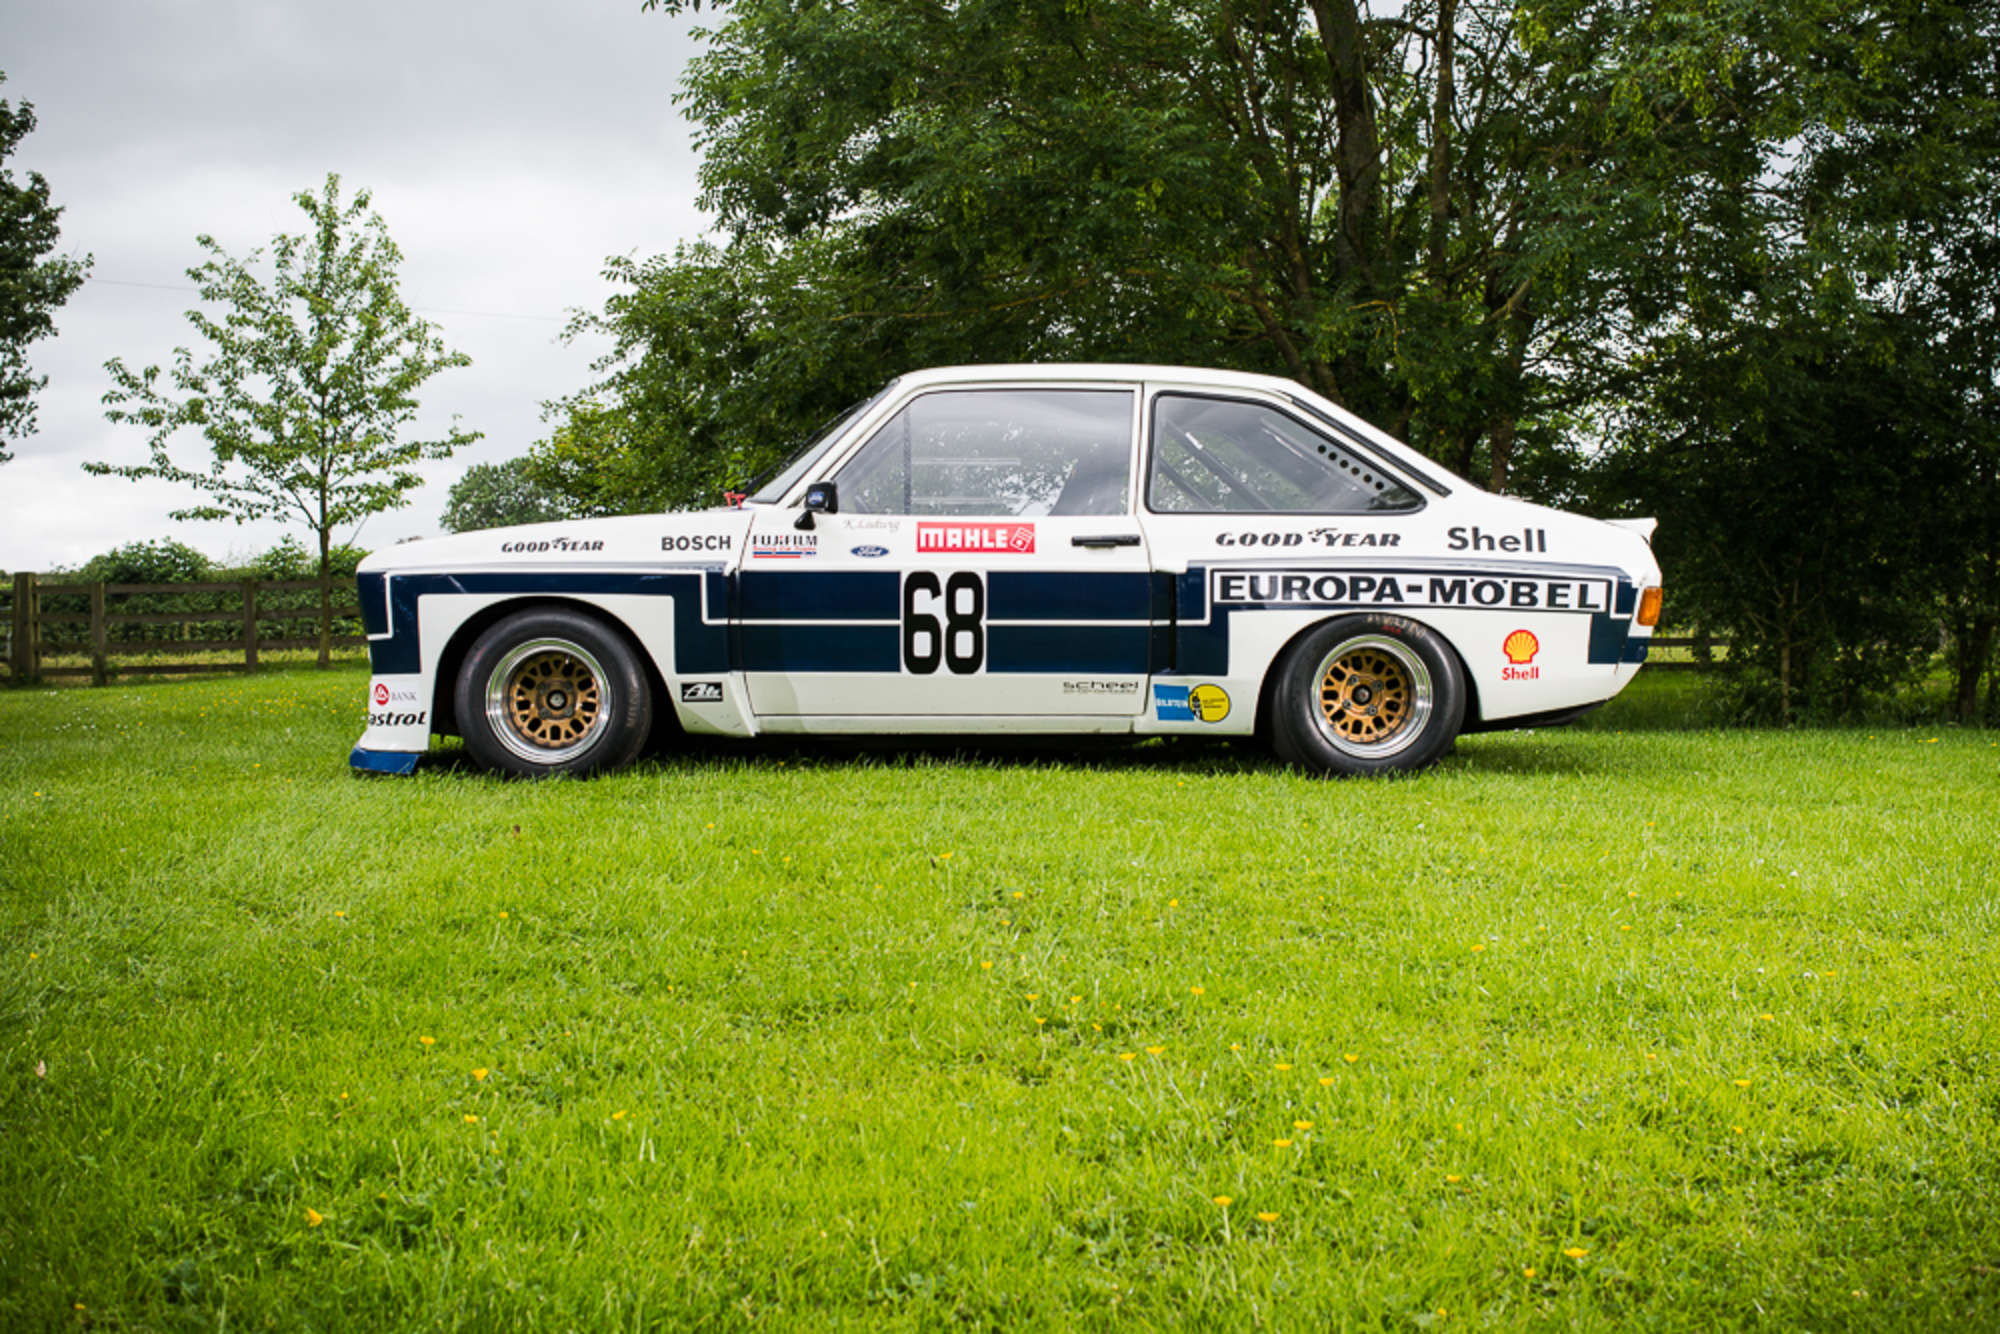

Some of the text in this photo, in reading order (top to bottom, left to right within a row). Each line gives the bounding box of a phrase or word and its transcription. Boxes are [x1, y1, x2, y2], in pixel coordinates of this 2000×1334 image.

[661, 535, 731, 551] BOSCH
[919, 527, 1008, 549] MAHLE
[1447, 526, 1546, 552] Shell
[1219, 575, 1601, 609] EUROPA-MÖBEL
[903, 571, 985, 674] 68
[1501, 666, 1540, 681] Shell
[368, 711, 426, 727] astrol
